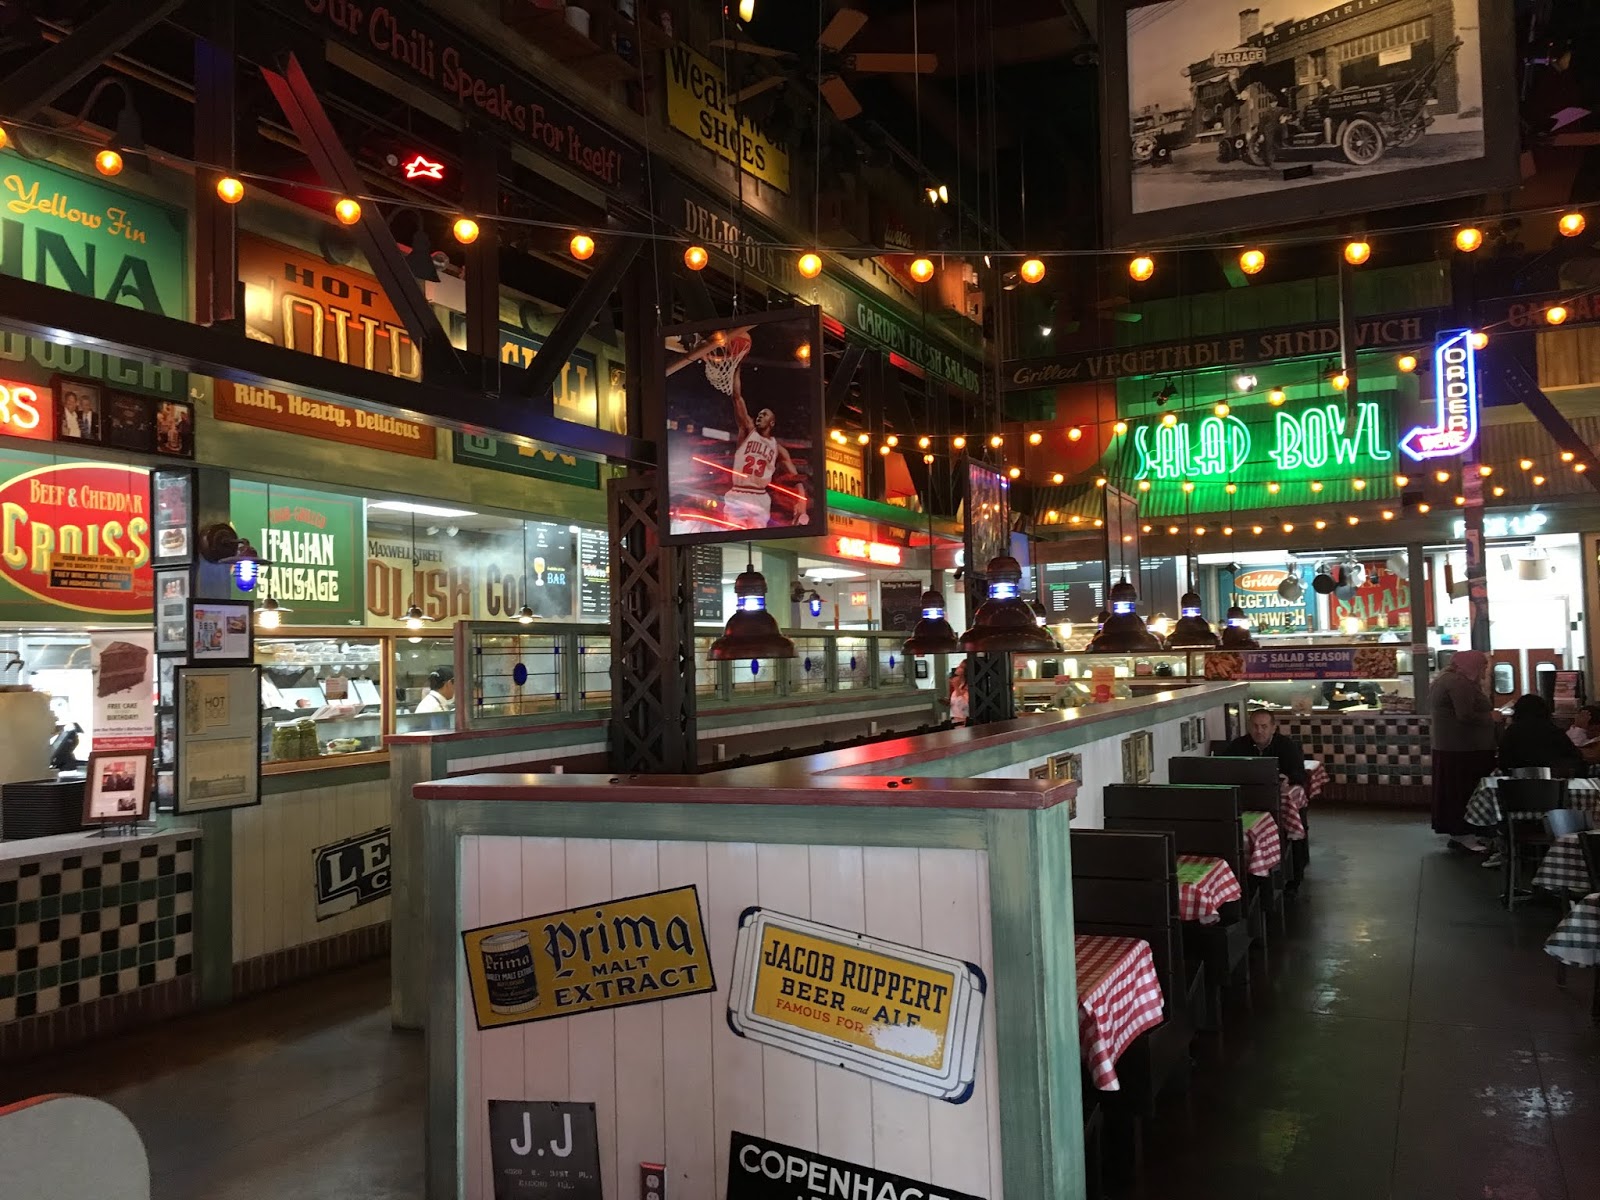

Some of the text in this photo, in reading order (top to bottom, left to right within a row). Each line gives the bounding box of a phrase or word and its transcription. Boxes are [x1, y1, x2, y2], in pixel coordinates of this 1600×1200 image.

[1218, 51, 1263, 64] GARAGE
[368, 6, 436, 80] Chili
[441, 45, 526, 132] Speaks
[531, 103, 564, 153] For
[567, 125, 622, 187] Itself!
[700, 110, 765, 171] SHOES
[4, 175, 147, 244] Yellow Fin
[684, 198, 776, 279] DELICOUS
[284, 263, 379, 307] HOT
[857, 303, 906, 353] GARDEN
[944, 355, 980, 394] SALADS
[1013, 362, 1082, 385] Grilled
[1087, 338, 1246, 377] VEGETABLE
[234, 382, 421, 440] Rich, Hearty, Delicious
[1444, 347, 1469, 431] ORDER
[744, 440, 775, 459] BULLS
[1134, 402, 1391, 480] SALAD BOWL
[742, 455, 768, 478] 23
[30, 479, 66, 505] BEEF
[67, 487, 78, 508] &
[80, 485, 143, 514] CHEDDAR
[261, 528, 335, 566] ITALIAN
[368, 540, 443, 567] MAXWELL STREET
[256, 565, 340, 602] SAUSAGE
[547, 572, 566, 586] BAR
[1247, 651, 1350, 663] IT'S SALAD SEASON
[205, 696, 225, 708] HOT
[326, 836, 391, 893] LE
[485, 953, 531, 971] Prima
[543, 910, 695, 973] Prima
[555, 964, 699, 1007] EXTRACT
[592, 956, 650, 977] MALT
[764, 939, 948, 1014] JACOB RUPPERT
[776, 998, 831, 1023] FAMOUS
[836, 1016, 864, 1033] FOR
[780, 976, 921, 1028] BEER and ALE
[510, 1111, 573, 1158] J.J
[739, 1144, 951, 1200] COPENHA
